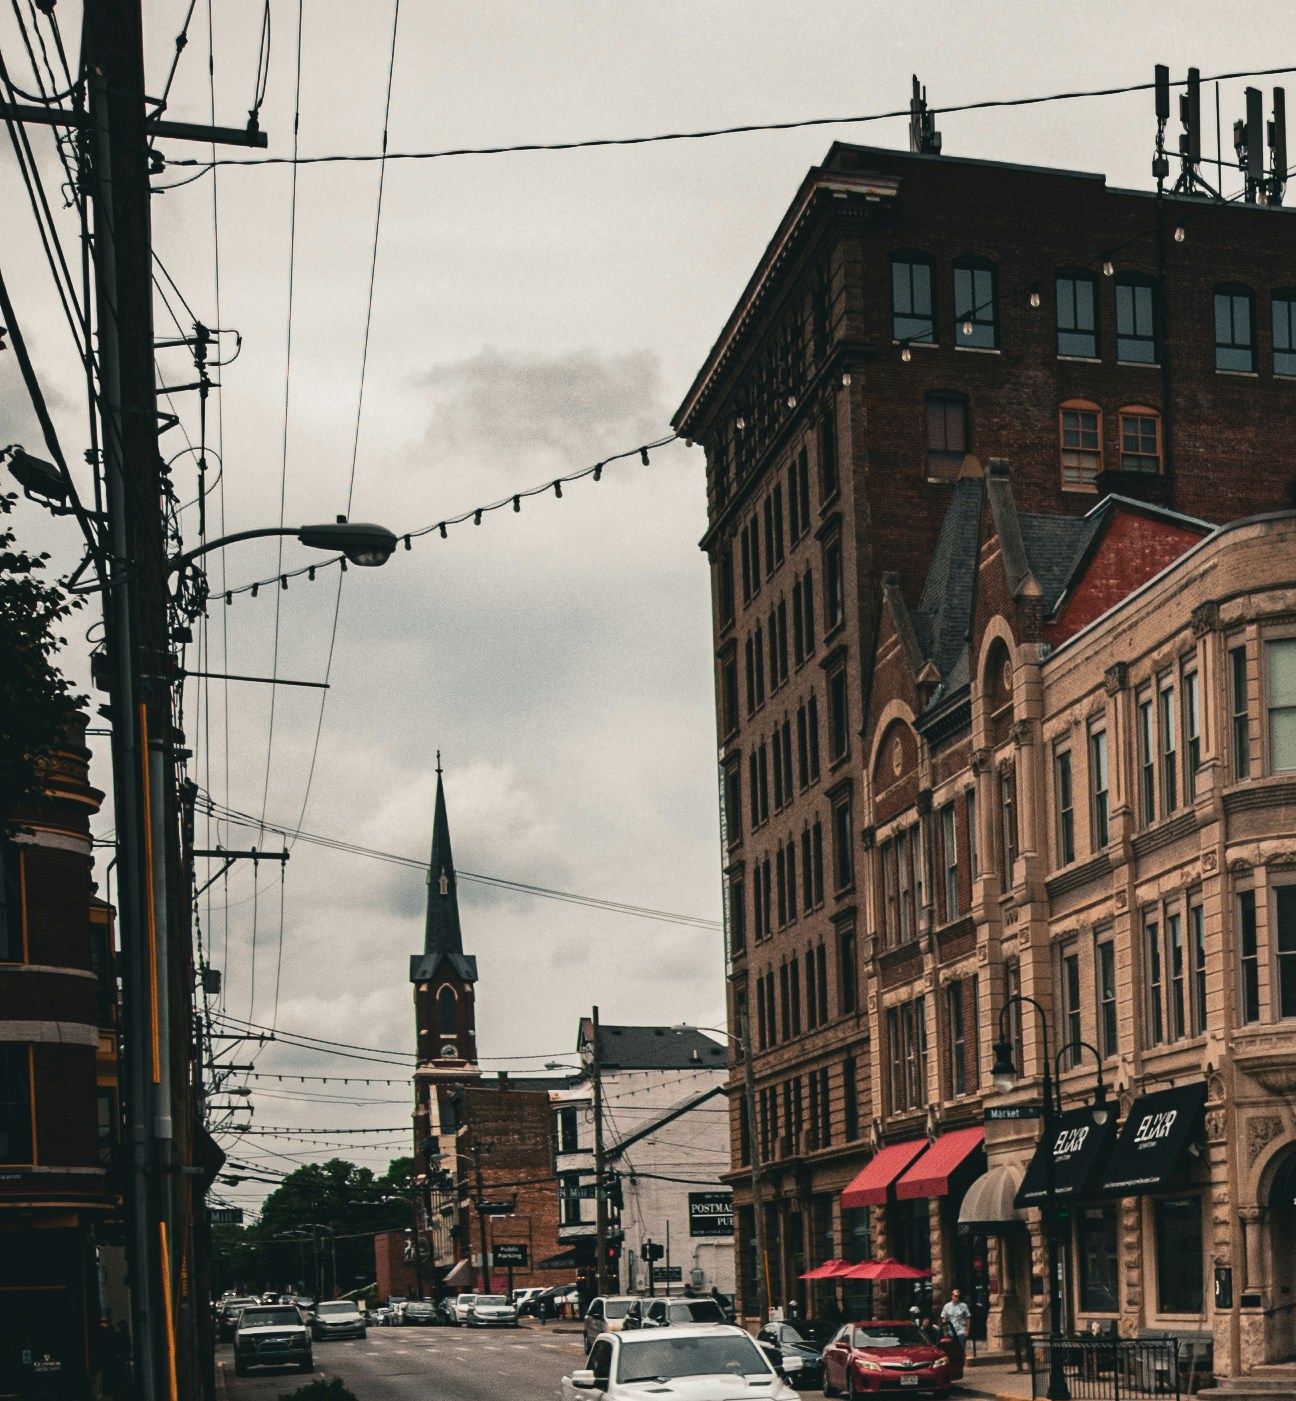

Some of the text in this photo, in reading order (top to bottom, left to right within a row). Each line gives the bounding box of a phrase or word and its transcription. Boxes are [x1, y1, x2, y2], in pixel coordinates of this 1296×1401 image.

[990, 1108, 1020, 1119] Market
[1134, 1109, 1178, 1143] ELIXIR
[1053, 1125, 1090, 1155] ELIXIR
[211, 1211, 232, 1222] Mill
